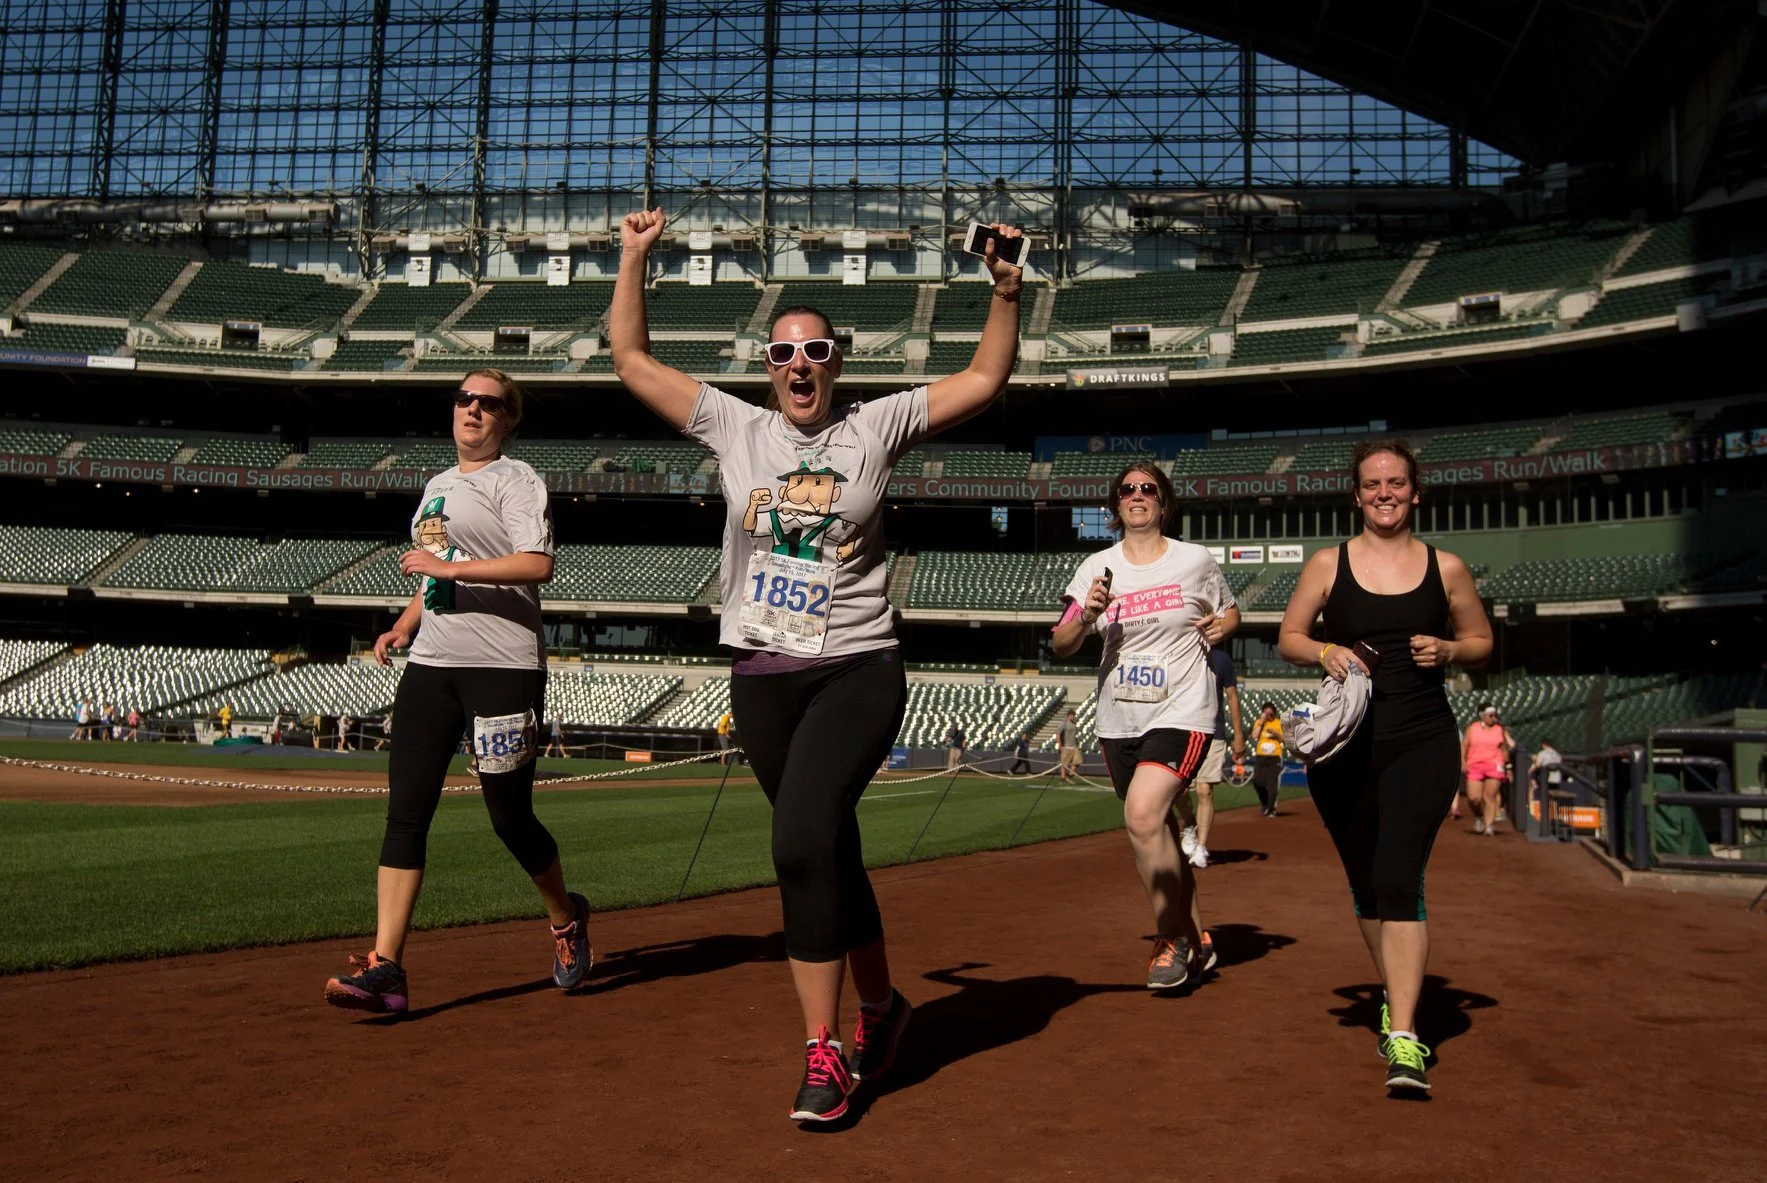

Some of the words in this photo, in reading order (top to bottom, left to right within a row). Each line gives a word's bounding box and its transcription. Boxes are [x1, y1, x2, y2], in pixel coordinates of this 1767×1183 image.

[0, 353, 28, 361] UNITY
[30, 354, 86, 364] FOUNDATION
[1090, 373, 1165, 383] DRAFTKINGS
[1111, 437, 1151, 451] PNC
[56, 459, 82, 477] 5K
[90, 462, 165, 481] Famous
[173, 466, 238, 487] Racing
[246, 470, 333, 489] Sausages
[341, 472, 427, 489] Run/Walk
[1494, 451, 1606, 479] Run/Walk
[925, 479, 1040, 499] Community
[1173, 479, 1198, 496] 5K
[1207, 476, 1287, 495] Famous
[1297, 474, 1355, 491] Racin
[752, 571, 829, 617] 1852
[1134, 587, 1181, 602] EVERYONE
[1131, 603, 1149, 614] LIKE
[1154, 601, 1161, 609] A
[1165, 598, 1183, 607] GIRL
[1117, 664, 1165, 687] 1450
